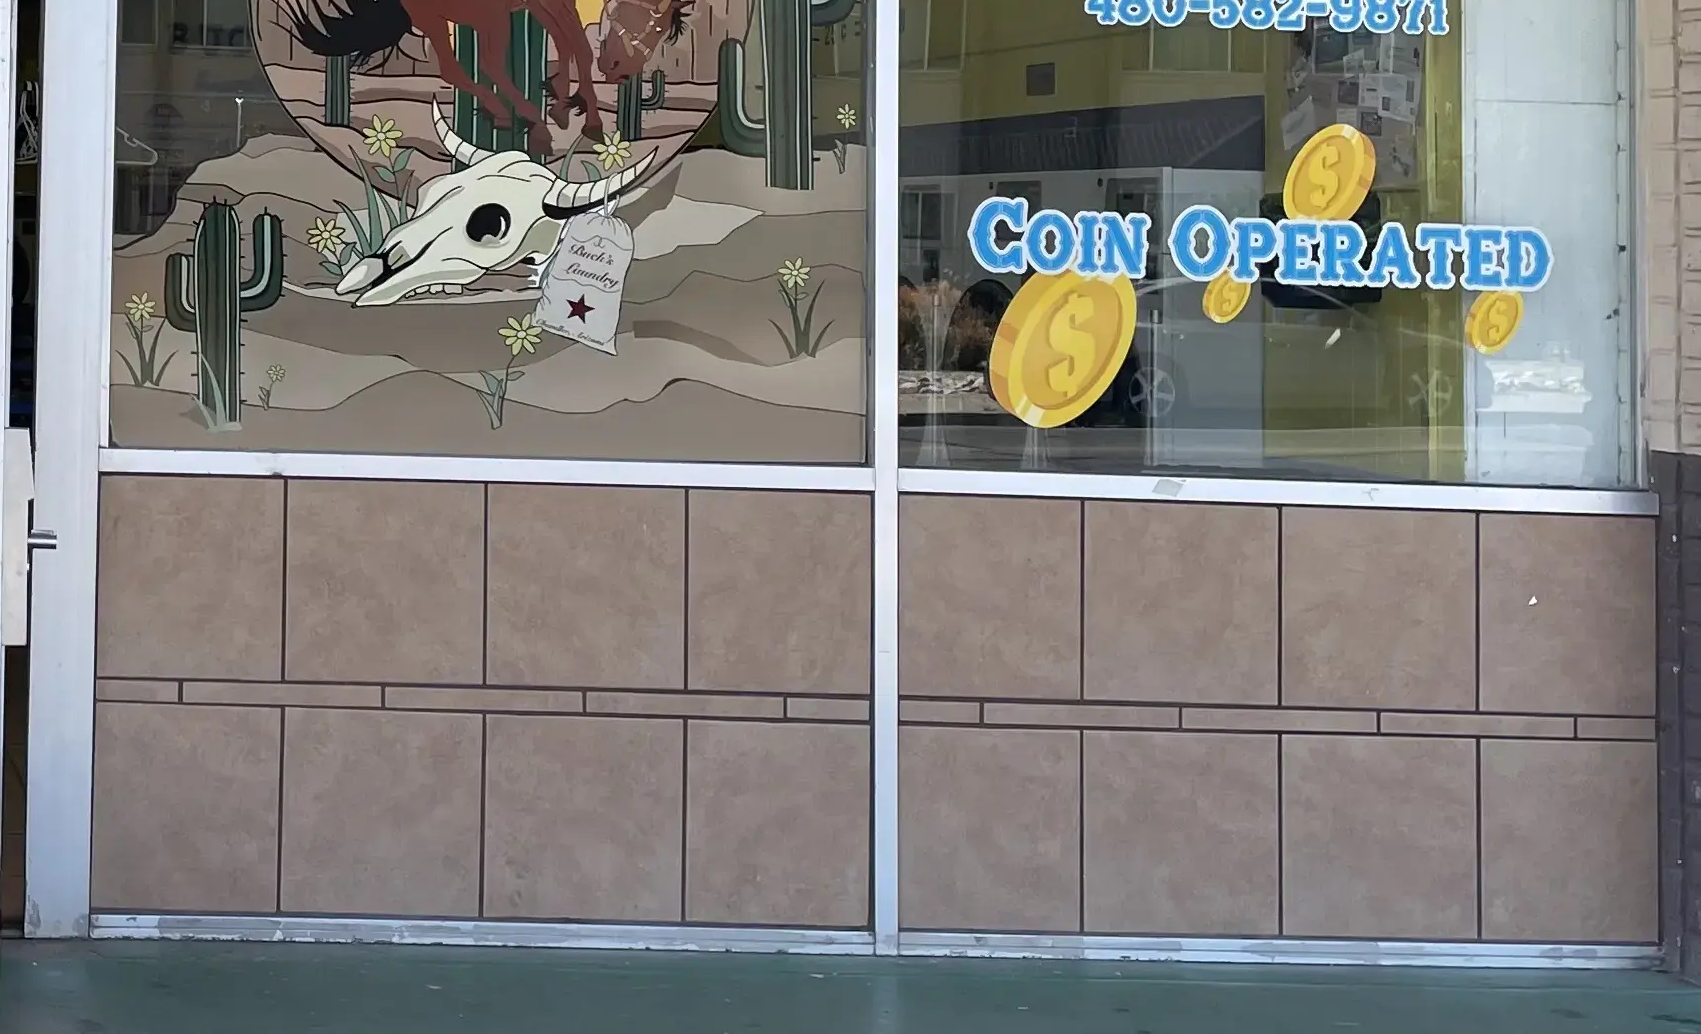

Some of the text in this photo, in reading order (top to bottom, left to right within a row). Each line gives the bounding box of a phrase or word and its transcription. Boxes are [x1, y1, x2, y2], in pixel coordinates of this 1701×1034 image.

[967, 196, 1555, 292] COIN OPERATED
[564, 262, 619, 289] Laundry
